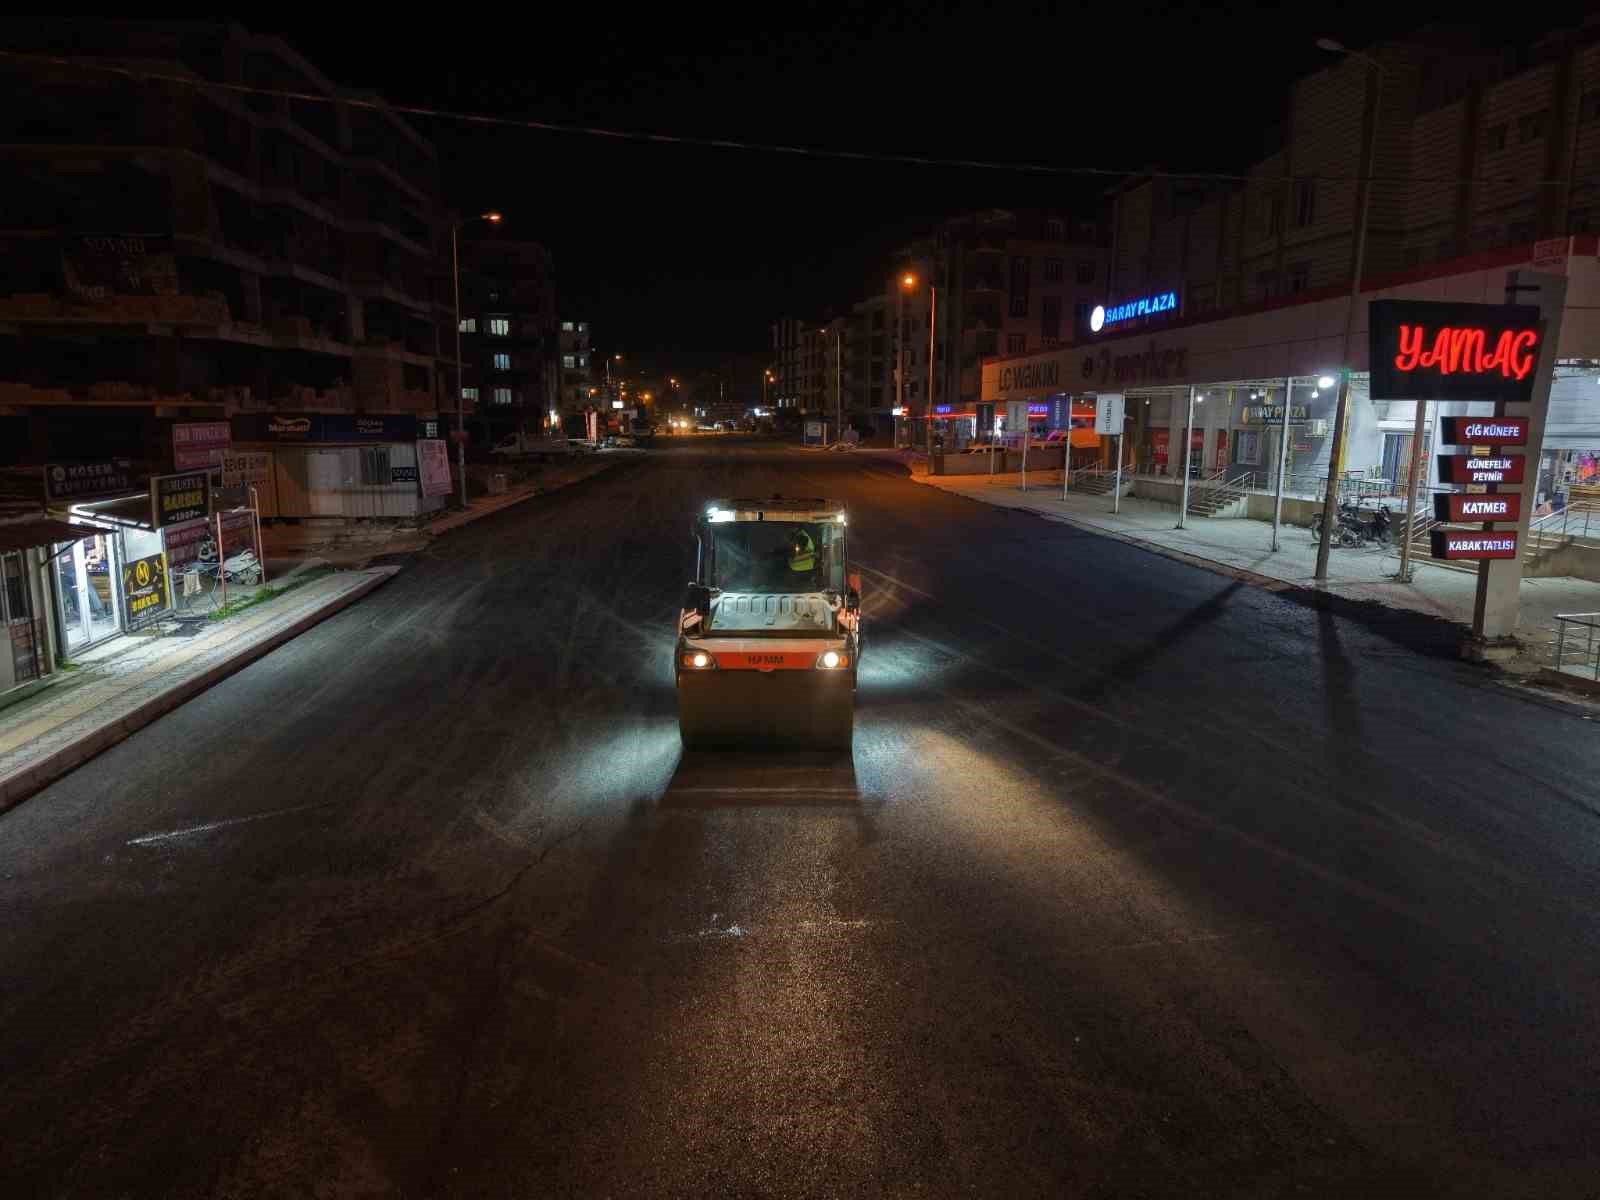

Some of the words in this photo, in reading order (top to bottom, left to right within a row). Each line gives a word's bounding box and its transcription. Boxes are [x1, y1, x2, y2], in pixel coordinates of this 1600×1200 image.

[1105, 302, 1137, 323] SARAY
[1138, 292, 1175, 316] PLAZA
[1394, 325, 1537, 380] YAMAÇ
[1465, 424, 1482, 439] ÇİĞ
[1483, 424, 1520, 437] KÜNEFE
[1466, 459, 1512, 470] KÜNEFELİK
[1473, 471, 1503, 482] PEYNİR
[1462, 502, 1507, 514] KATMER
[1449, 540, 1481, 551] KABAK
[1482, 540, 1514, 551] TATLISI
